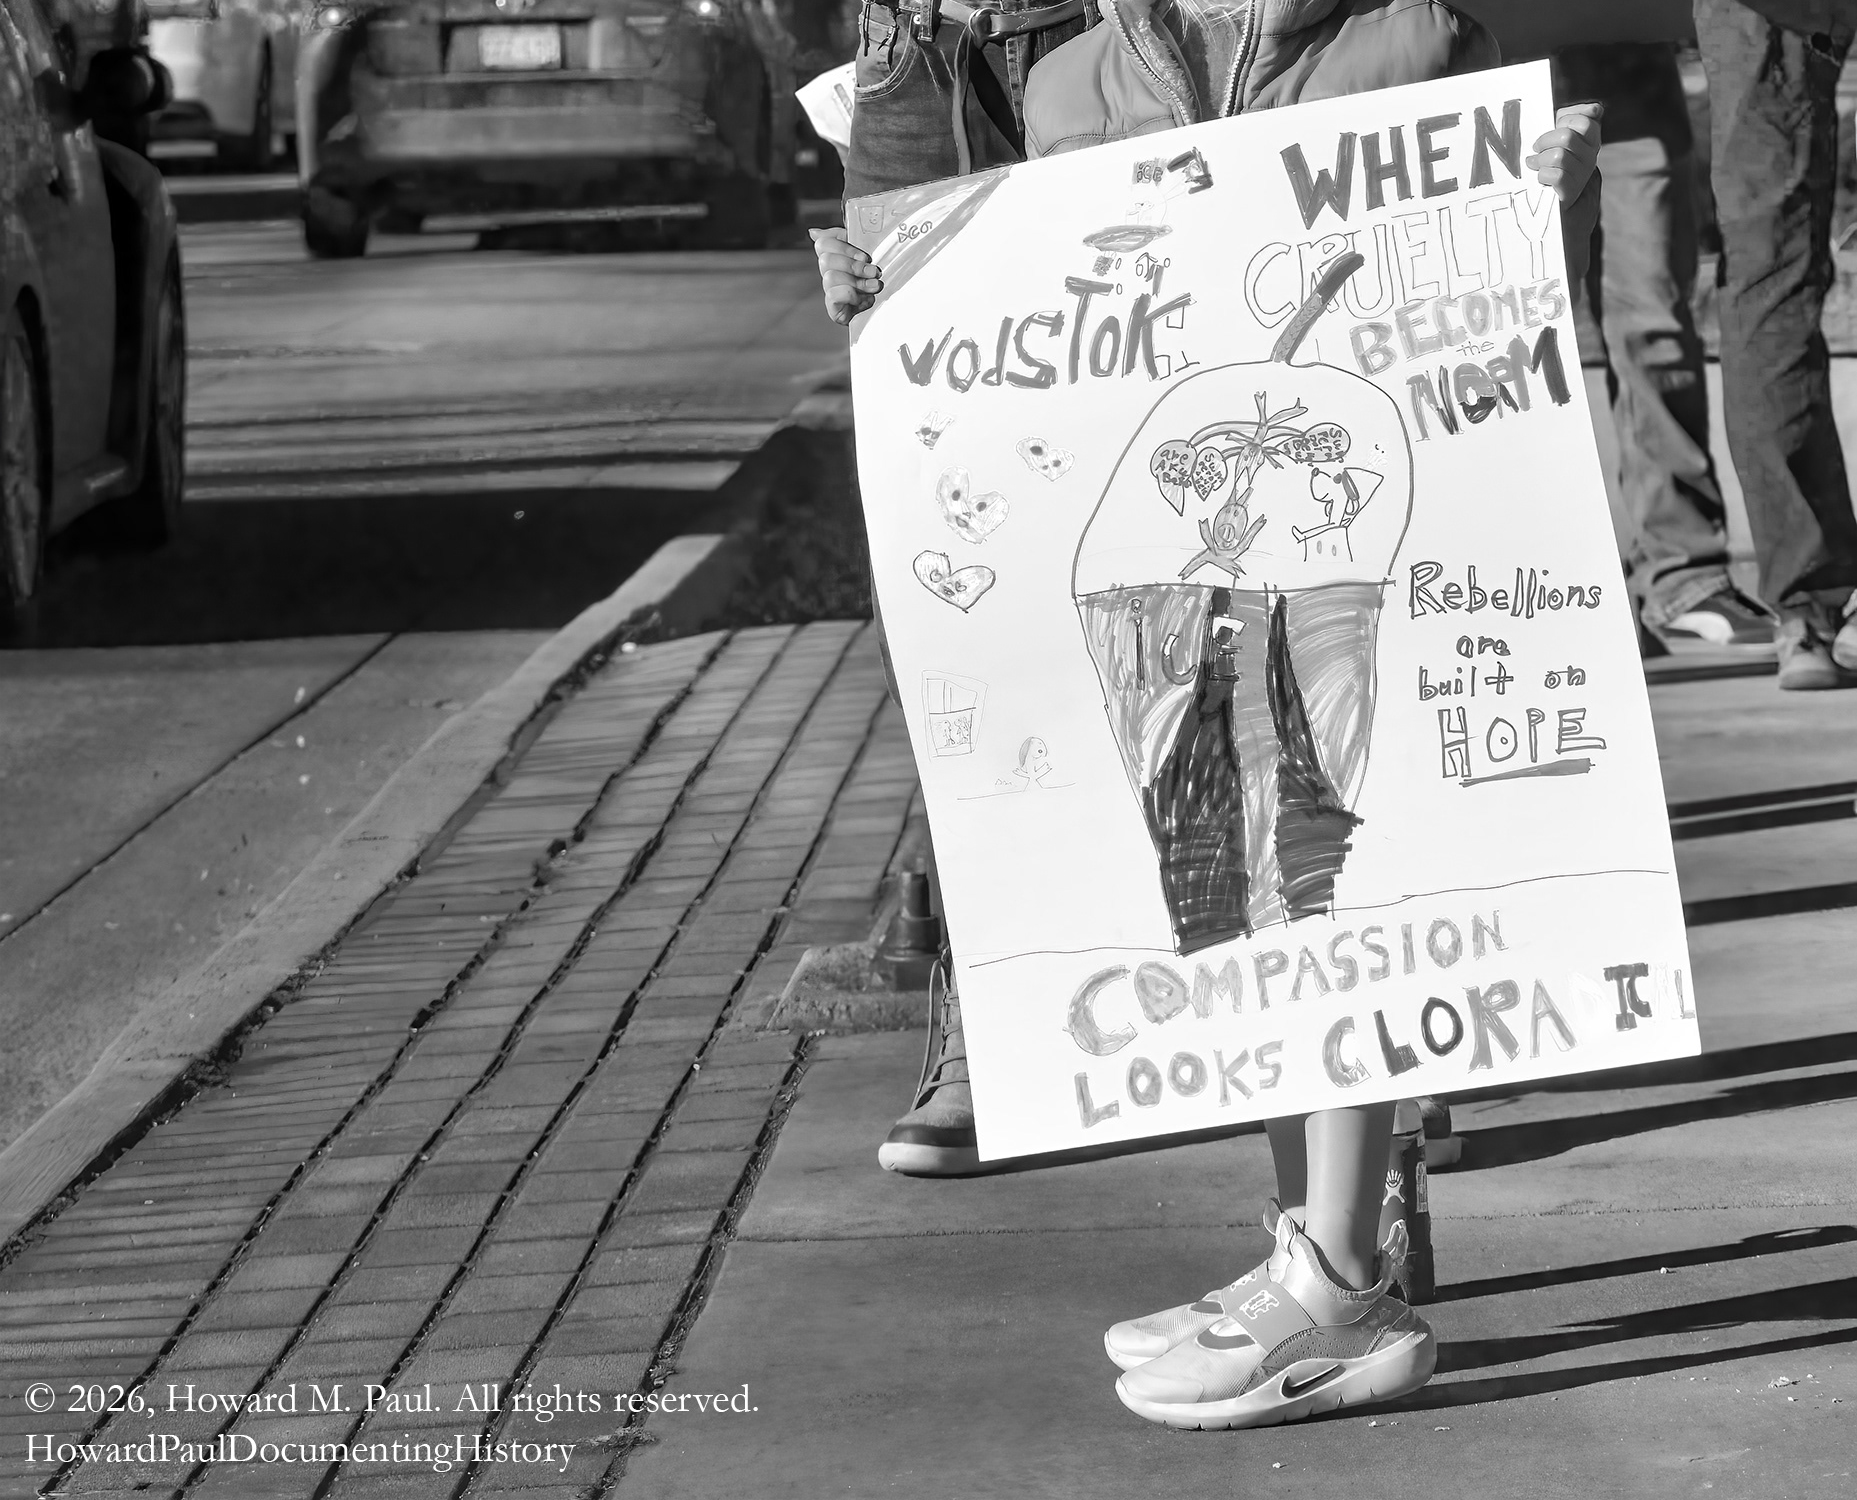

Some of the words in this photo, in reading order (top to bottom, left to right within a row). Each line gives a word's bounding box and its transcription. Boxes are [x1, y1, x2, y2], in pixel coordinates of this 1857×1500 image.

[1280, 98, 1524, 231] WHEN
[1244, 185, 1556, 329] CRUELTY
[1349, 278, 1567, 377] BECOMES
[1455, 338, 1495, 357] the
[1405, 325, 1572, 442] NORM
[1408, 560, 1602, 620] Rebellions
[1419, 661, 1514, 701] built
[1543, 665, 1586, 689] on
[1456, 635, 1511, 659] are
[1437, 706, 1607, 779] HOPE
[1063, 909, 1508, 1056] COMPASSION
[1074, 1039, 1284, 1129] LOOKS
